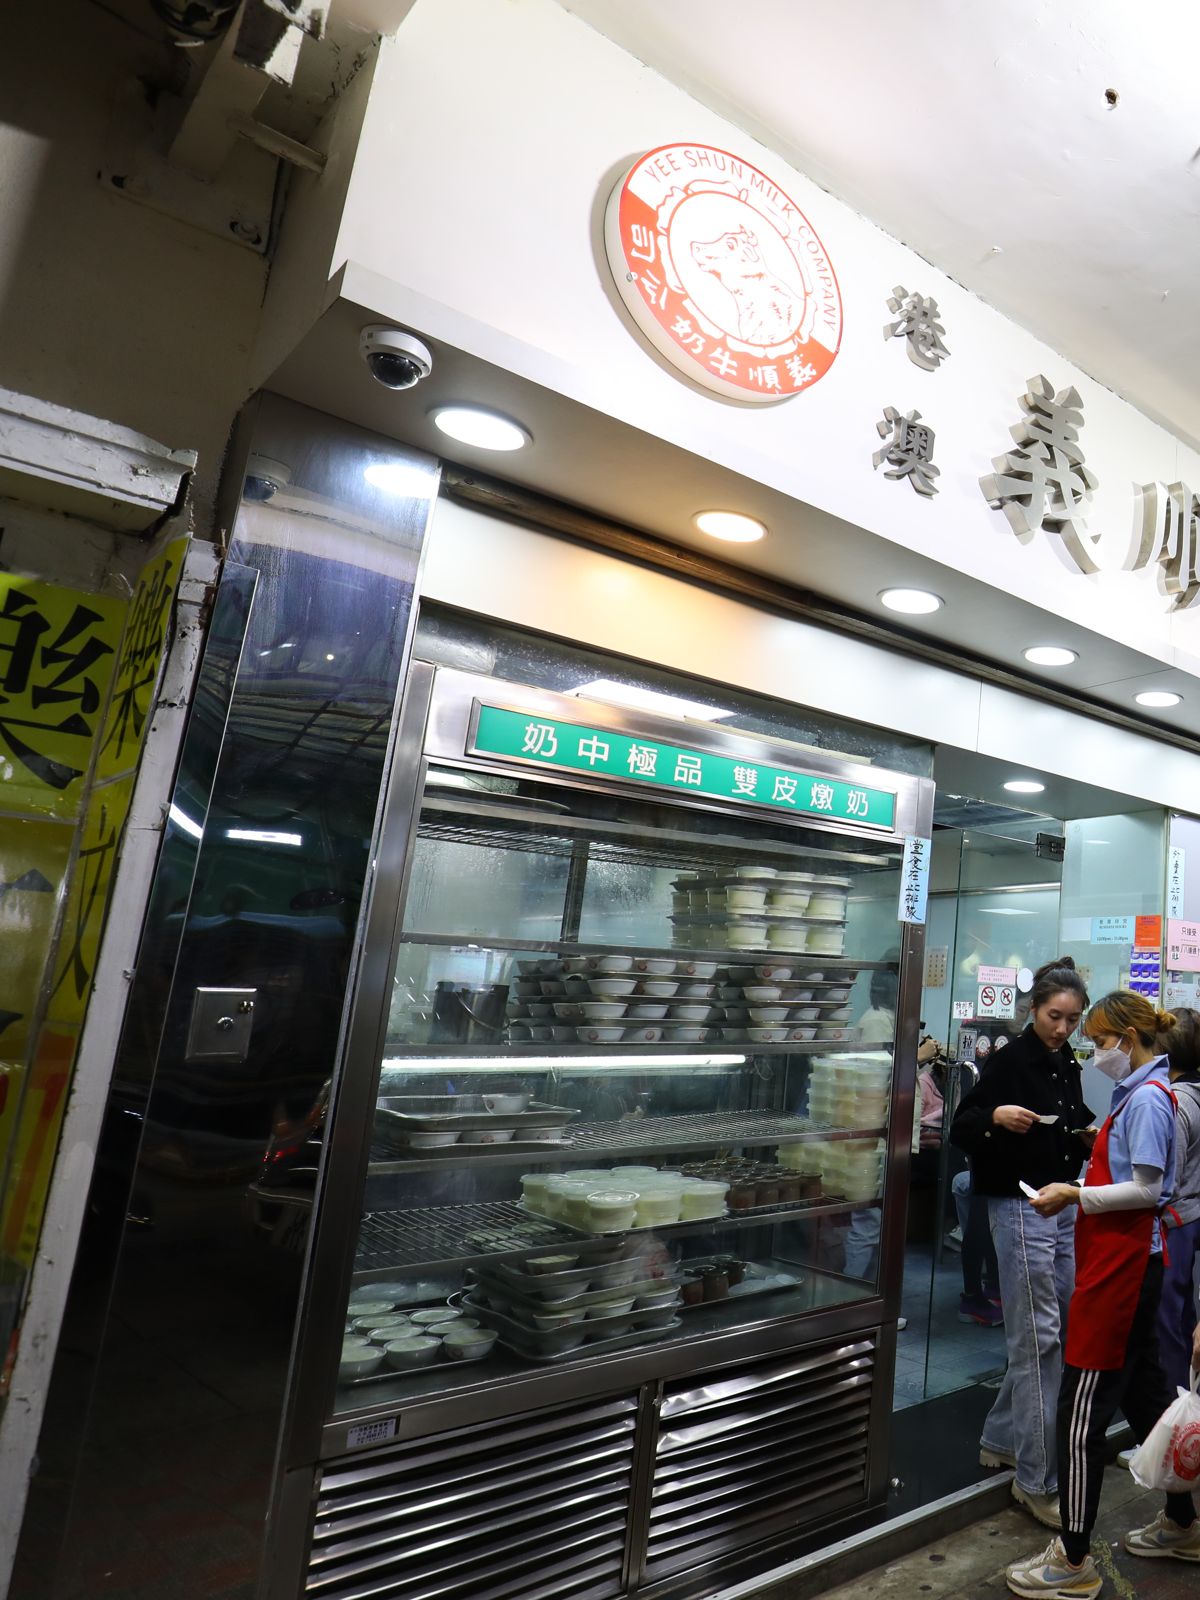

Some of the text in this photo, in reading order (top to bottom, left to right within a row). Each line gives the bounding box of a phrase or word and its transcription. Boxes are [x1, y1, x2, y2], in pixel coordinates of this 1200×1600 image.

[644, 150, 838, 332] YEE SHUN MILK COMPANY
[872, 285, 951, 500] 港澳
[522, 721, 869, 818] 奶中極品 雙皮燉奶
[962, 1034, 973, 1049] 拉
